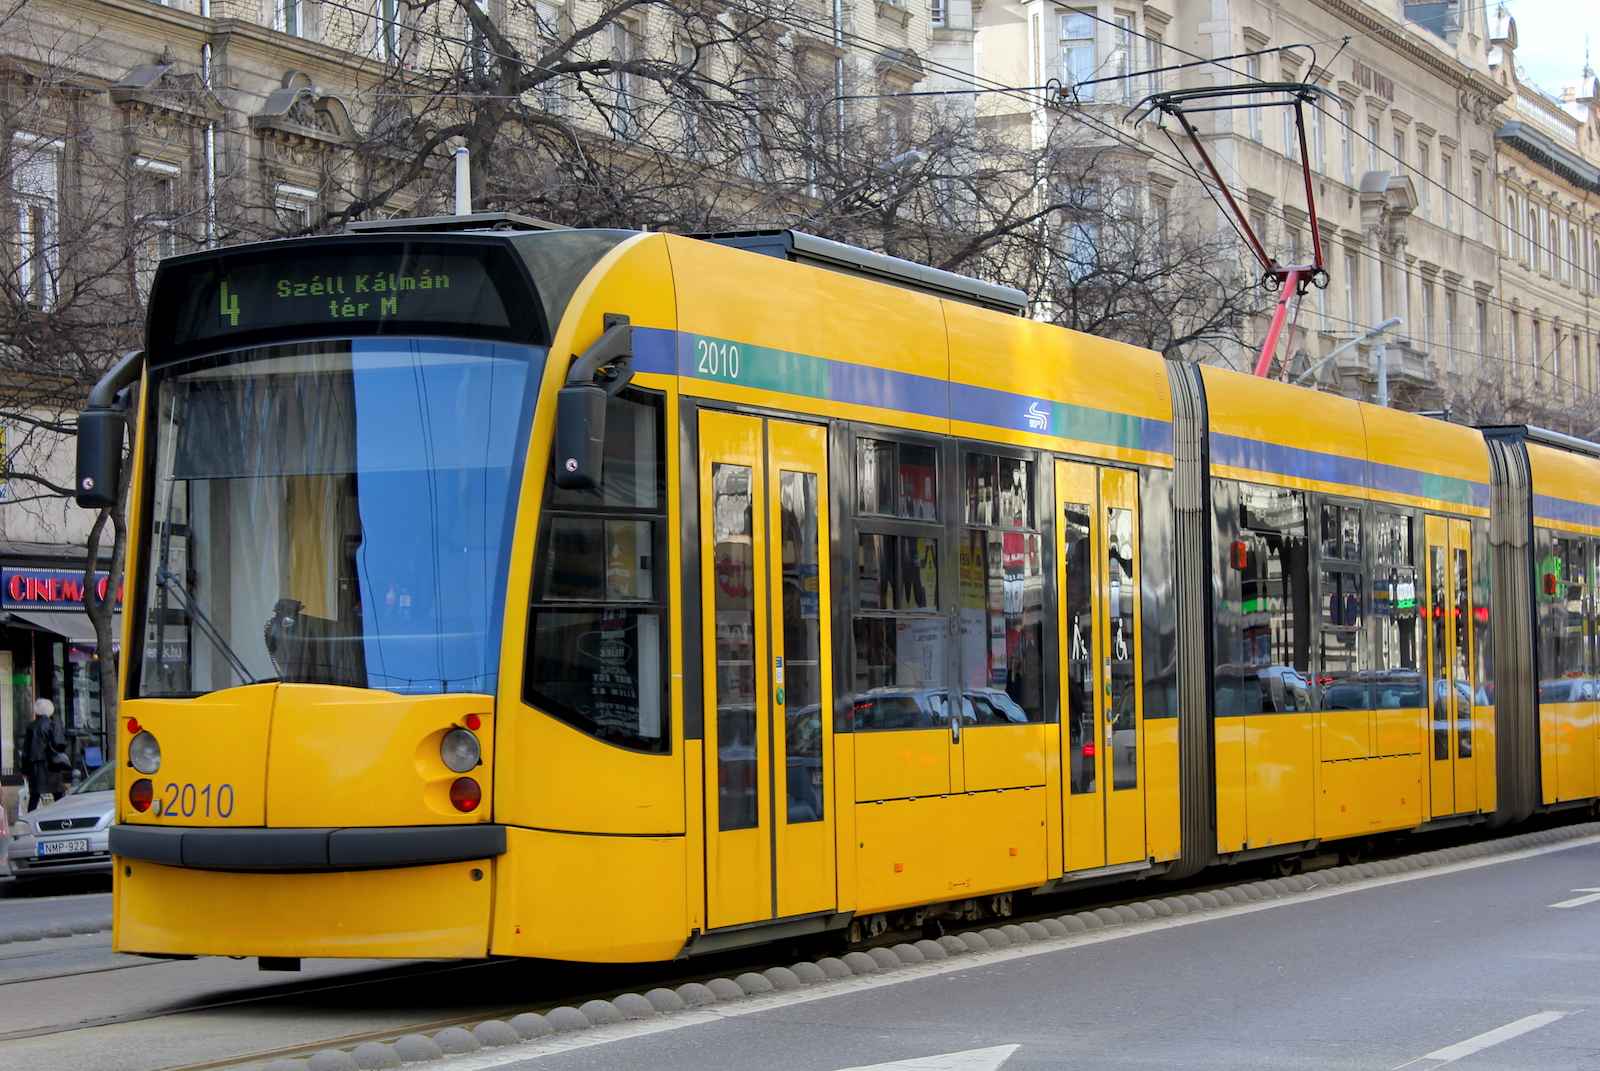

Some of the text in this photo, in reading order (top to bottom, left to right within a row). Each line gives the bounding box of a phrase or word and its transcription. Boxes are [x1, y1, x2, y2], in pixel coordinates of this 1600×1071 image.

[277, 269, 450, 297] Széll Kálmán
[220, 281, 240, 326] 4
[329, 297, 398, 318] tér M
[698, 339, 739, 379] 2010
[164, 783, 234, 818] 2010
